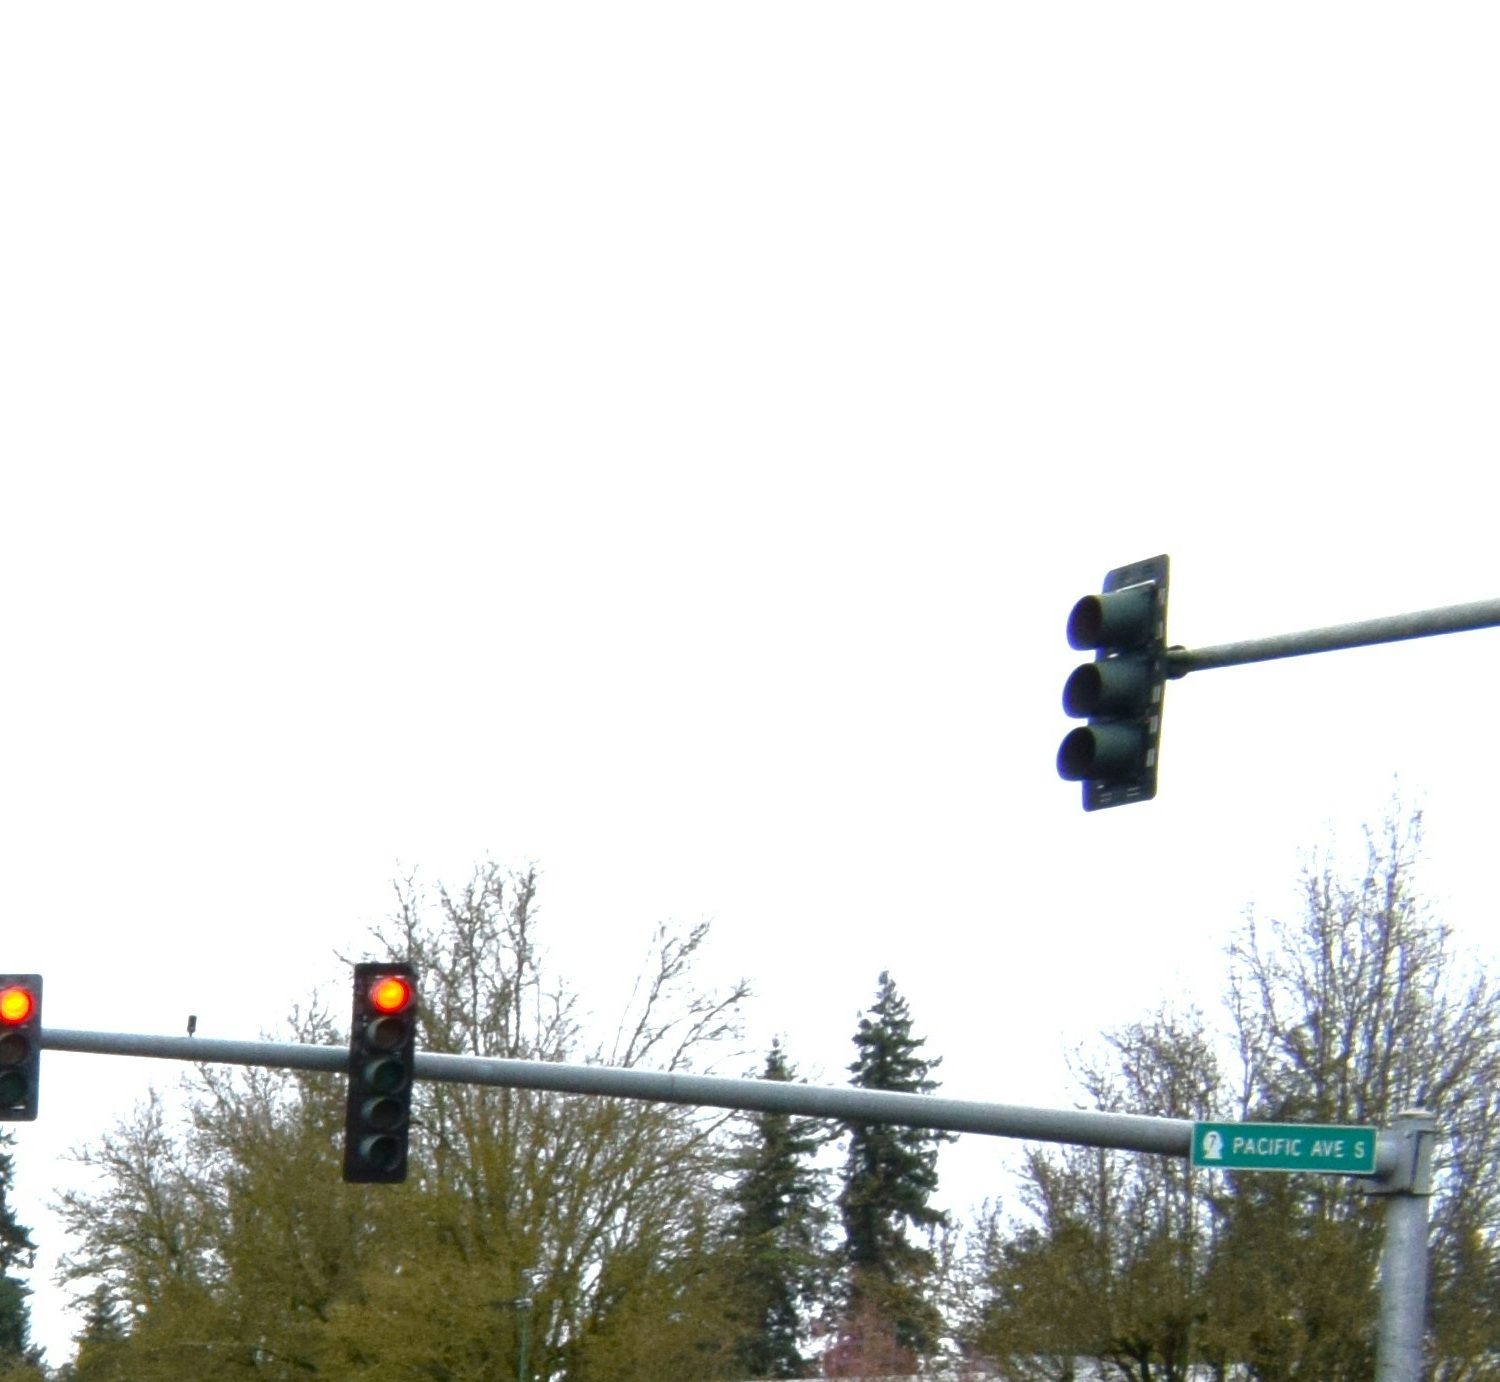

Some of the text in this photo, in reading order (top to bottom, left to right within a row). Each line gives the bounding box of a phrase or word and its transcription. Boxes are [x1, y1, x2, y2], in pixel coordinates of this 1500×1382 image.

[1232, 1137, 1302, 1157] PACIFIC
[1311, 1140, 1344, 1158] AVE
[1354, 1141, 1365, 1159] S
